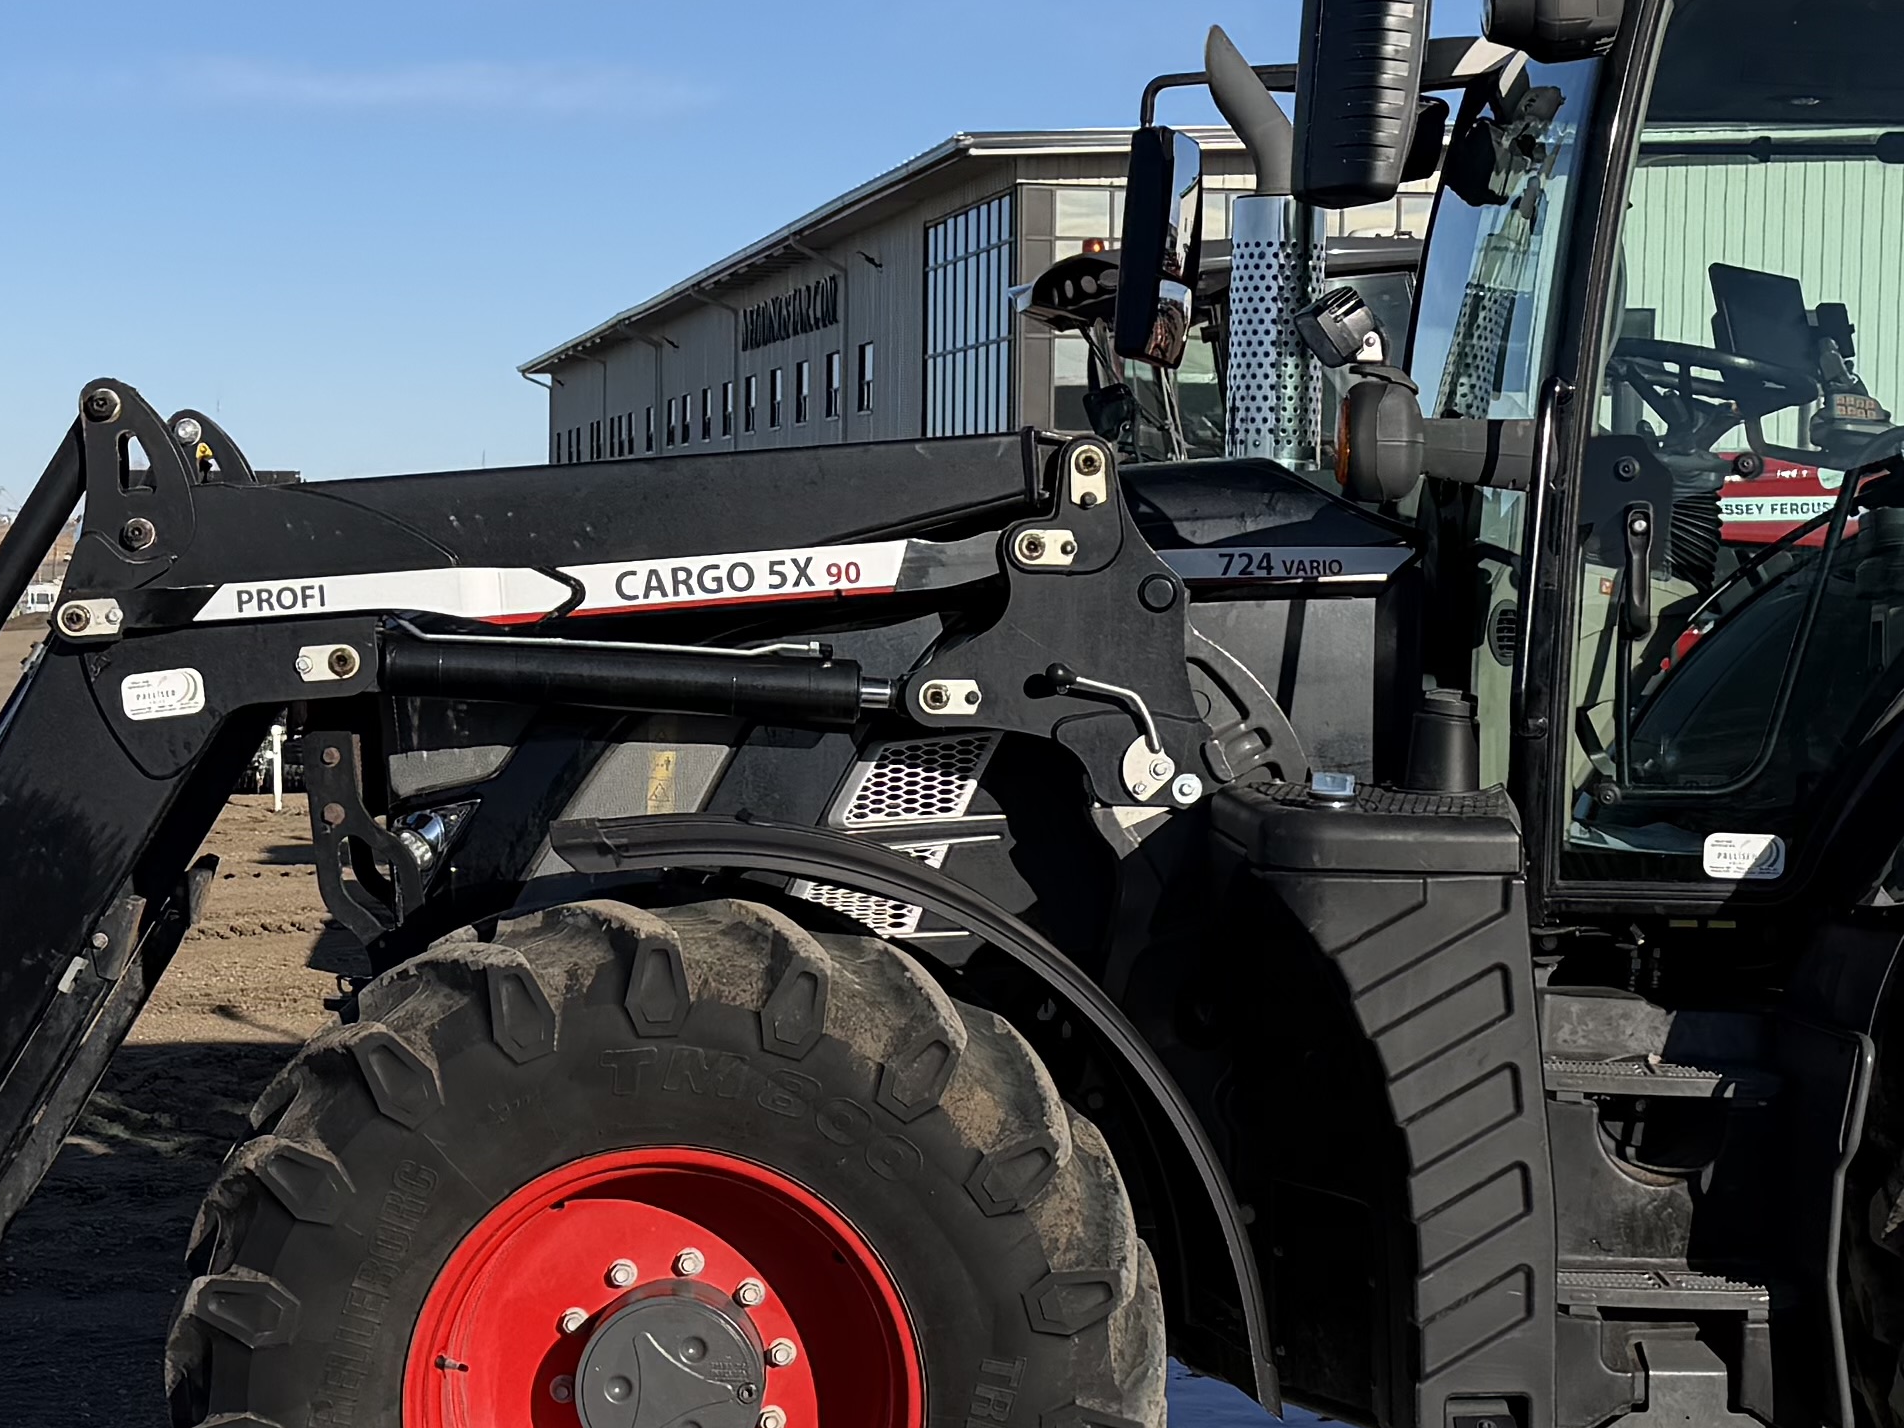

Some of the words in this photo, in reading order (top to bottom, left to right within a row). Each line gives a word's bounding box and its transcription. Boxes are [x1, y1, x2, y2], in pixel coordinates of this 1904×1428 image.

[1724, 503, 1764, 515] SSEY
[1770, 502, 1831, 515] FERGUS
[1218, 552, 1274, 576] 724
[1281, 559, 1343, 575] VARIO
[615, 561, 756, 602] CARGO
[768, 556, 816, 590] 5X
[826, 561, 861, 586] 90
[236, 584, 326, 613] PROFI
[599, 1045, 924, 1180] TM800
